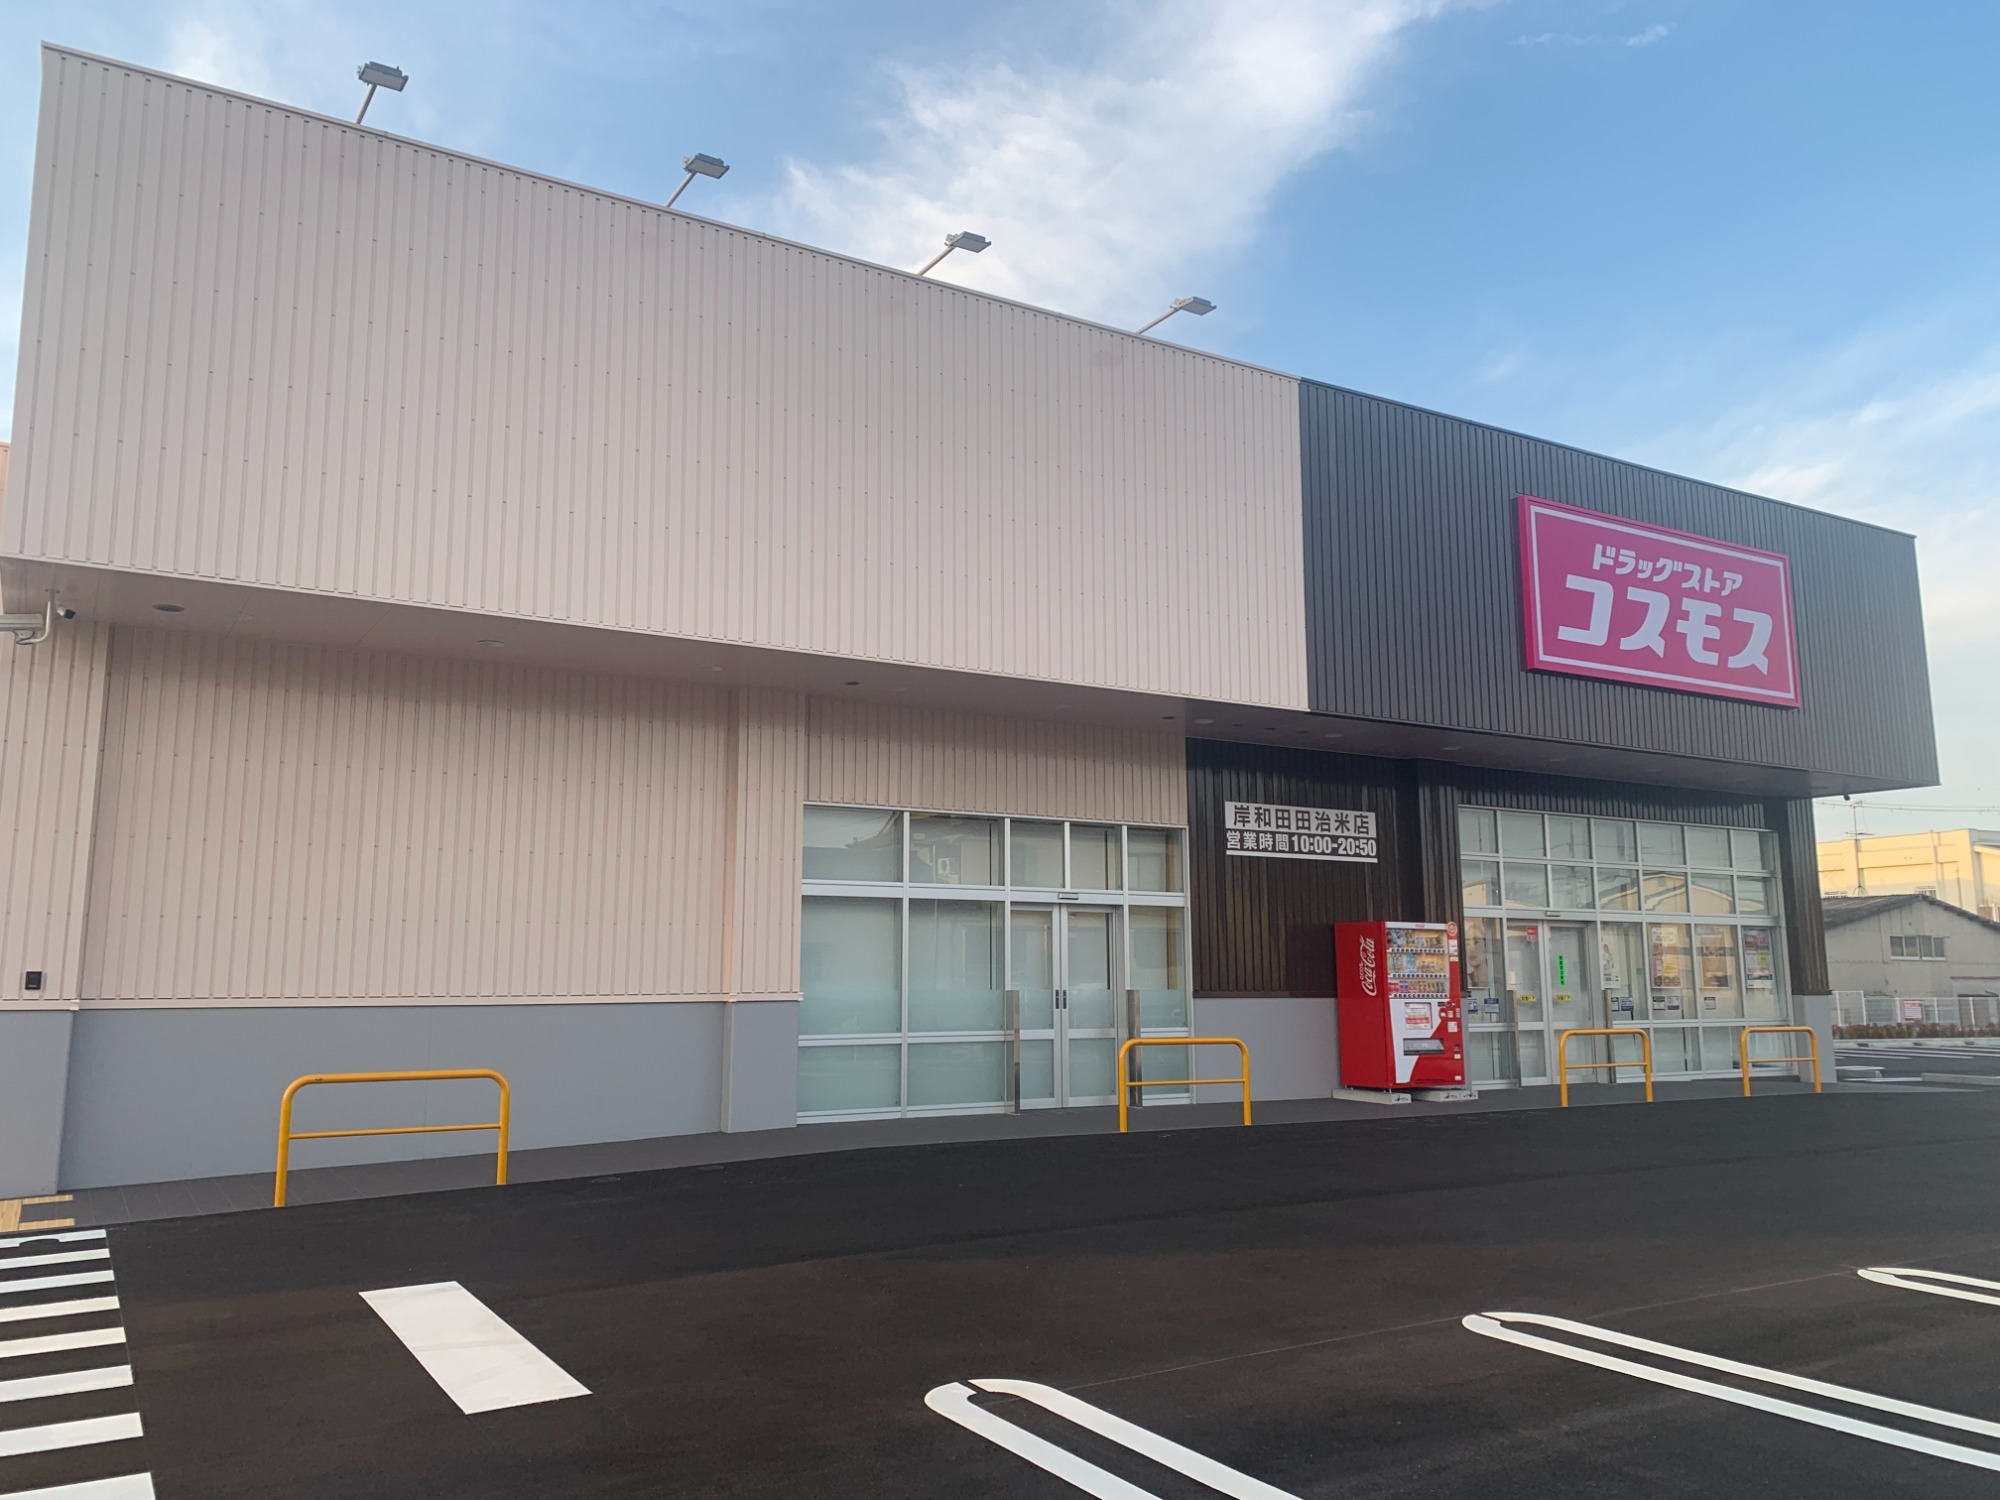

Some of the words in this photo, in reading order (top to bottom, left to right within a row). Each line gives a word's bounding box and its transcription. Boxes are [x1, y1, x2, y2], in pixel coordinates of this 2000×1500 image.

[1592, 543, 1743, 596] ドラッグストア
[1557, 574, 1773, 676] コスモス
[1233, 804, 1370, 836] 岸和田田治米店
[1360, 935, 1377, 996] Coca-Cola
